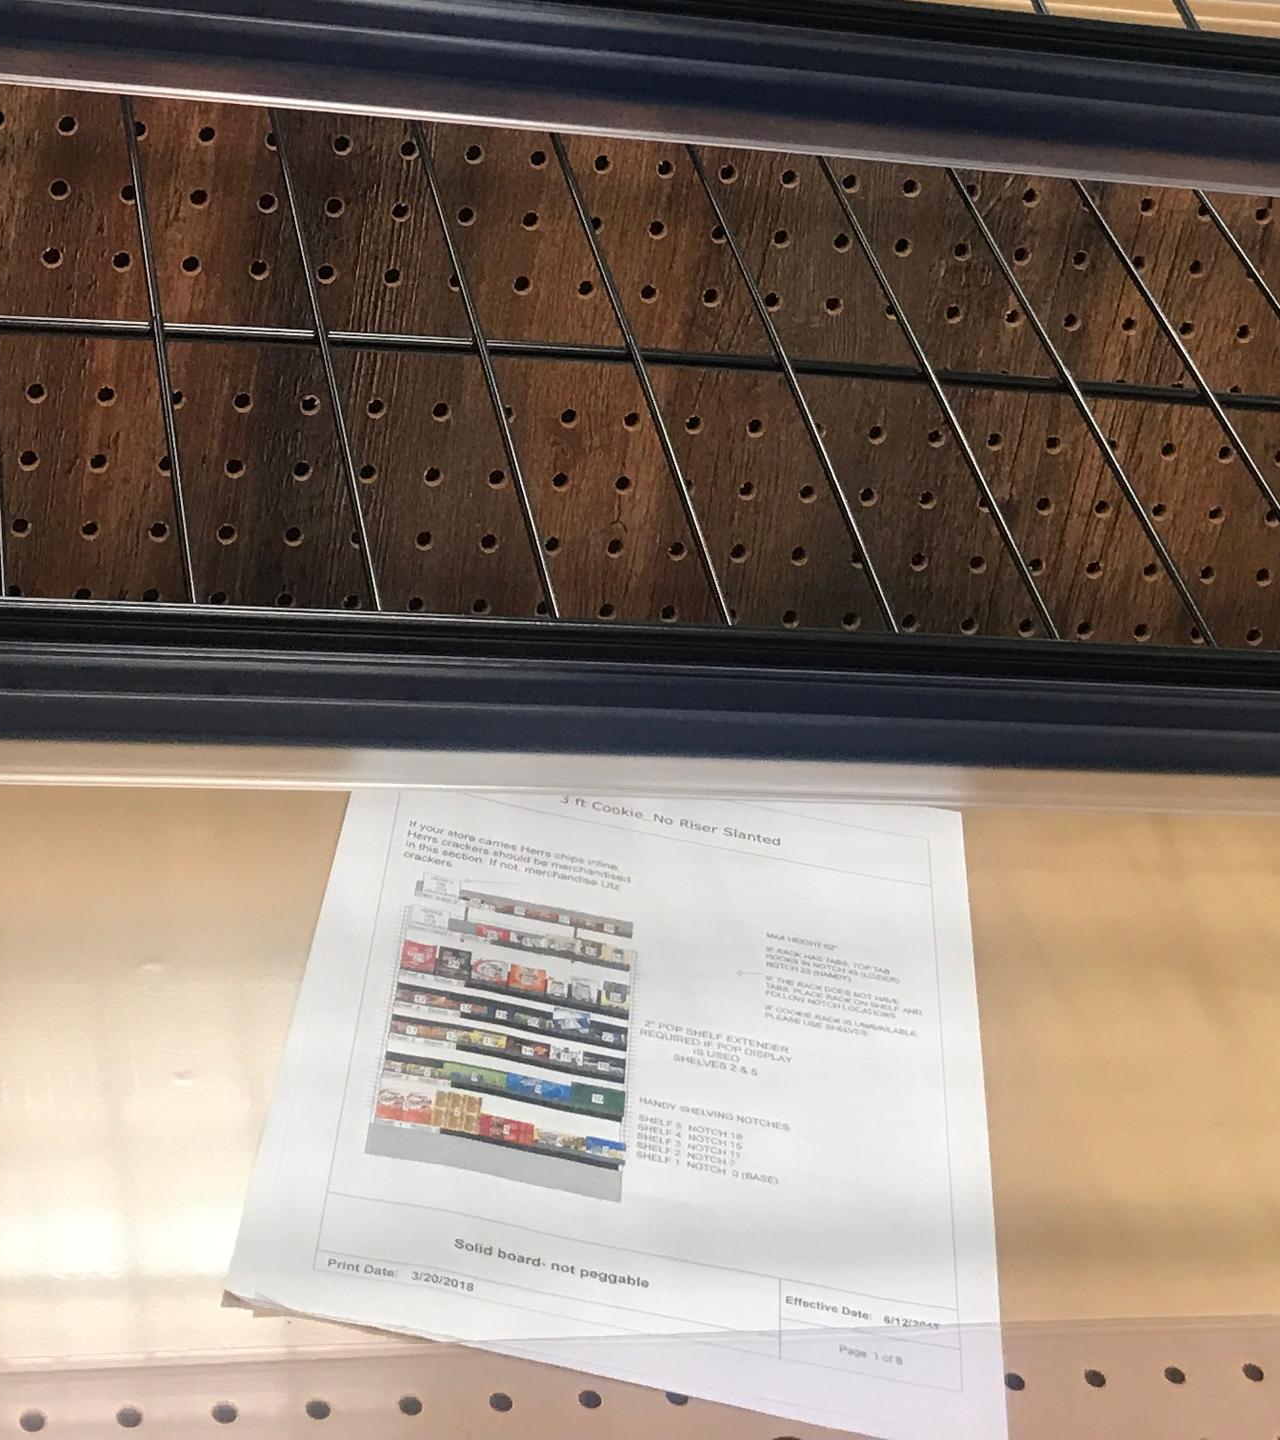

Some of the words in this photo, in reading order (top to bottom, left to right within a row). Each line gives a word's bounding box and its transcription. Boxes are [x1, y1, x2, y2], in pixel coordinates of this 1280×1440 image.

[420, 823, 445, 835] your
[448, 829, 476, 843] store
[479, 836, 517, 852] carries
[575, 797, 587, 808] ft
[679, 818, 718, 835] Riser
[722, 827, 782, 847] Slanted
[419, 842, 439, 855] this
[524, 866, 598, 887] merchandise
[441, 838, 490, 857] crackers
[492, 848, 531, 865] should
[533, 855, 549, 868] be
[551, 860, 632, 884] merchandised
[639, 1028, 701, 1047] REQUIRED
[745, 1047, 792, 1063] DISPLAY
[726, 1035, 790, 1053] EXTENDER
[673, 1053, 728, 1070] SHELVES
[639, 1096, 677, 1111] HANDY
[680, 1104, 734, 1121] SHELVING
[736, 1114, 791, 1131] NOTCHES
[688, 1124, 728, 1138] NOTCH
[687, 1143, 727, 1157] NOTCH
[686, 1161, 727, 1176] NOTCH
[327, 1257, 361, 1274] Print
[410, 1270, 475, 1293] 3/20/2018
[454, 1238, 493, 1257] Solid
[497, 1247, 546, 1268] board-
[551, 1260, 576, 1276] not
[579, 1268, 650, 1290] peggable
[785, 1295, 838, 1314] Effective
[841, 1306, 872, 1320] Date:
